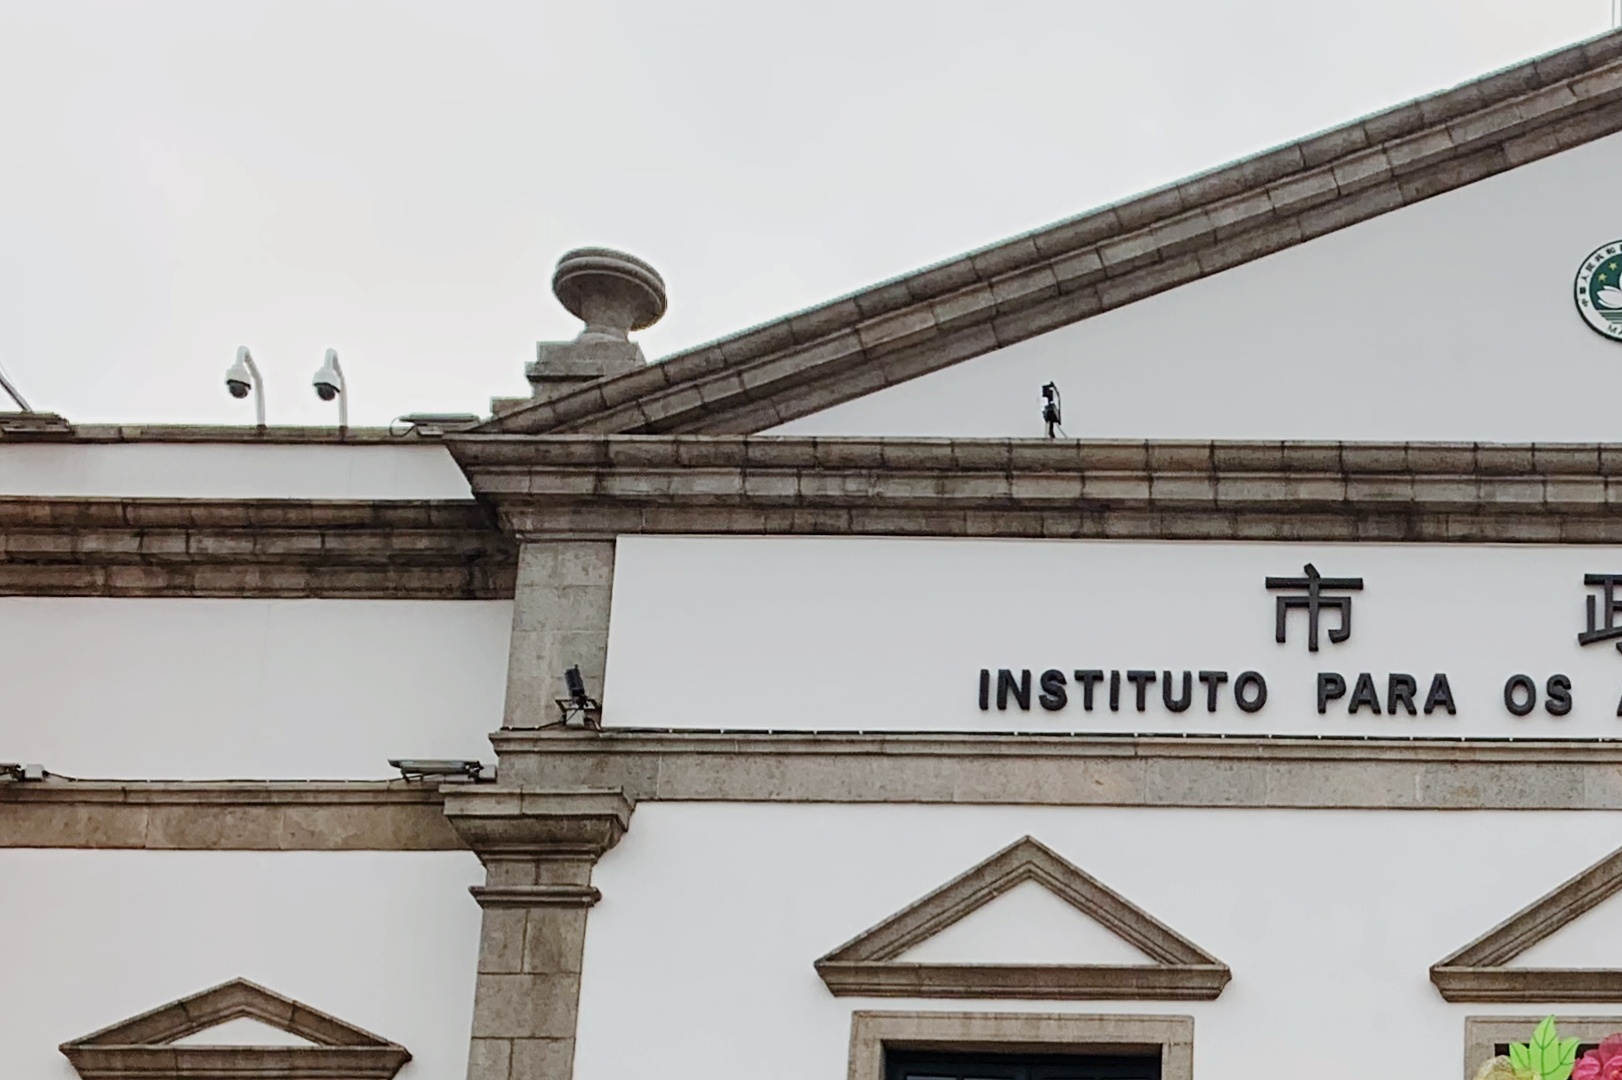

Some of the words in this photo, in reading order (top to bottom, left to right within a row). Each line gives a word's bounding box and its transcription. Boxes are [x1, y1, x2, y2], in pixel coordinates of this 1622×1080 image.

[979, 668, 1268, 713] INSTITUTO
[1317, 671, 1457, 716] PARA
[1504, 673, 1574, 717] OS
